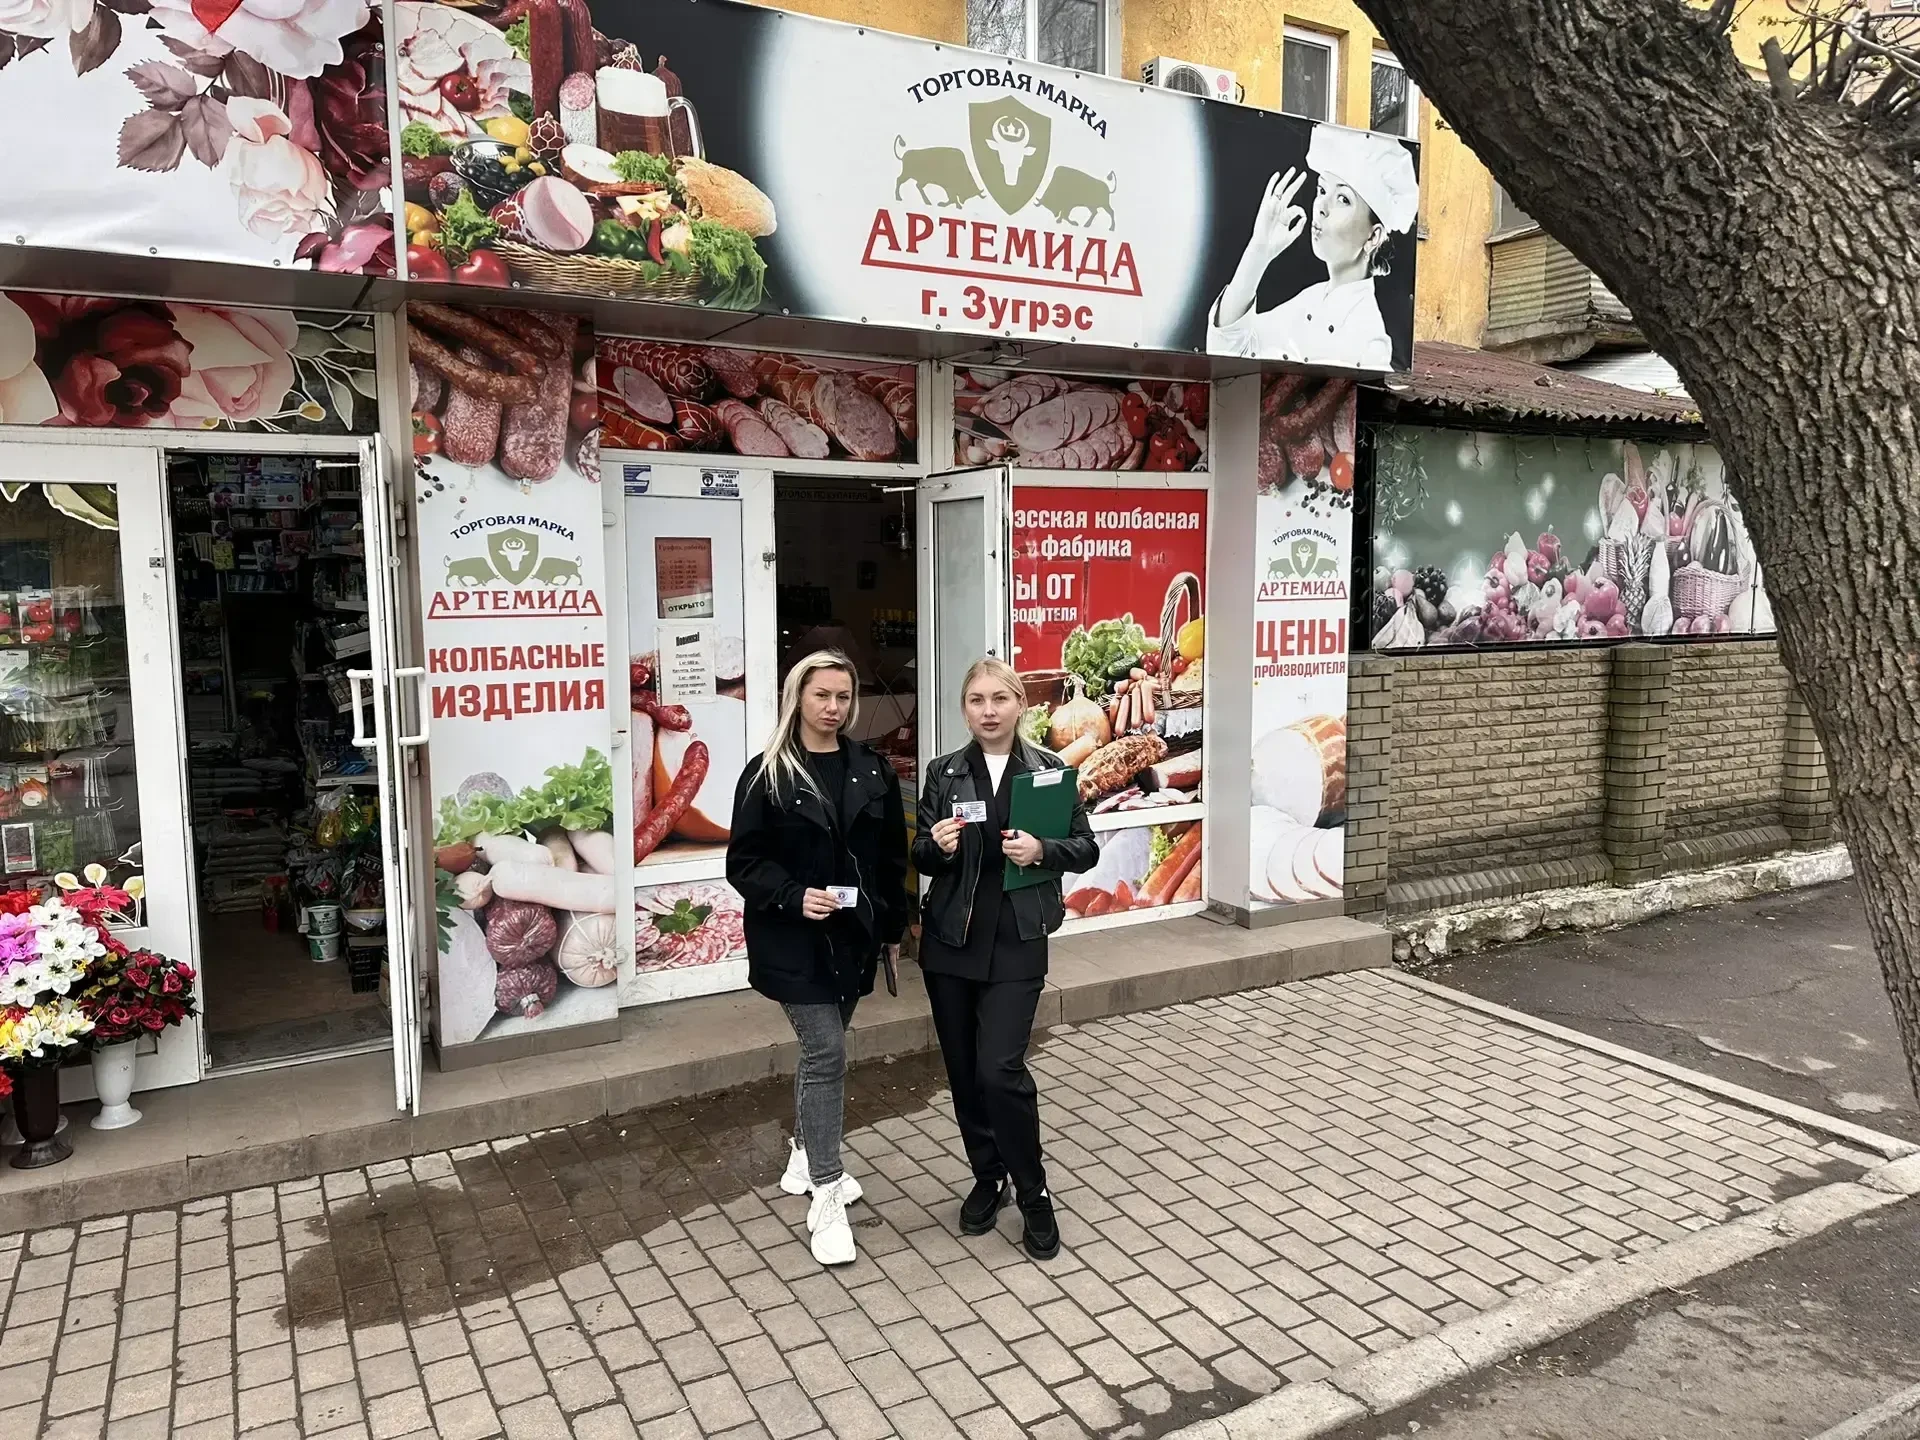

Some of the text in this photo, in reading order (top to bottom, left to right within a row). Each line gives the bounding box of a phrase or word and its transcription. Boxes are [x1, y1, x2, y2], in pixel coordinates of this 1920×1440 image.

[907, 68, 1109, 140] ТОРГОВАЯ МАРКА
[861, 208, 1143, 296] АРТЕМИДА
[921, 286, 1094, 332] г. Зугрэс
[450, 515, 576, 541] ТОРГОВАЯ МАРКА
[1012, 507, 1200, 530] эсская колбасная
[1041, 534, 1132, 562] фабрика
[1272, 528, 1337, 546] ТОРГОВАЯ МАРКА
[1014, 573, 1076, 600] Ы ОТ
[1257, 580, 1348, 601] АРТЕМИДА
[427, 589, 603, 618] АРТЕМИДА
[668, 601, 705, 612] ОТКРЫТО
[1255, 618, 1346, 663] ЦЕНЫ
[428, 643, 605, 673] КОЛБАСНЫЕ
[1254, 661, 1346, 678] ПРОИЗВОДИТЕЛЯ
[432, 679, 605, 722] ИЗДЕЛИЯ
